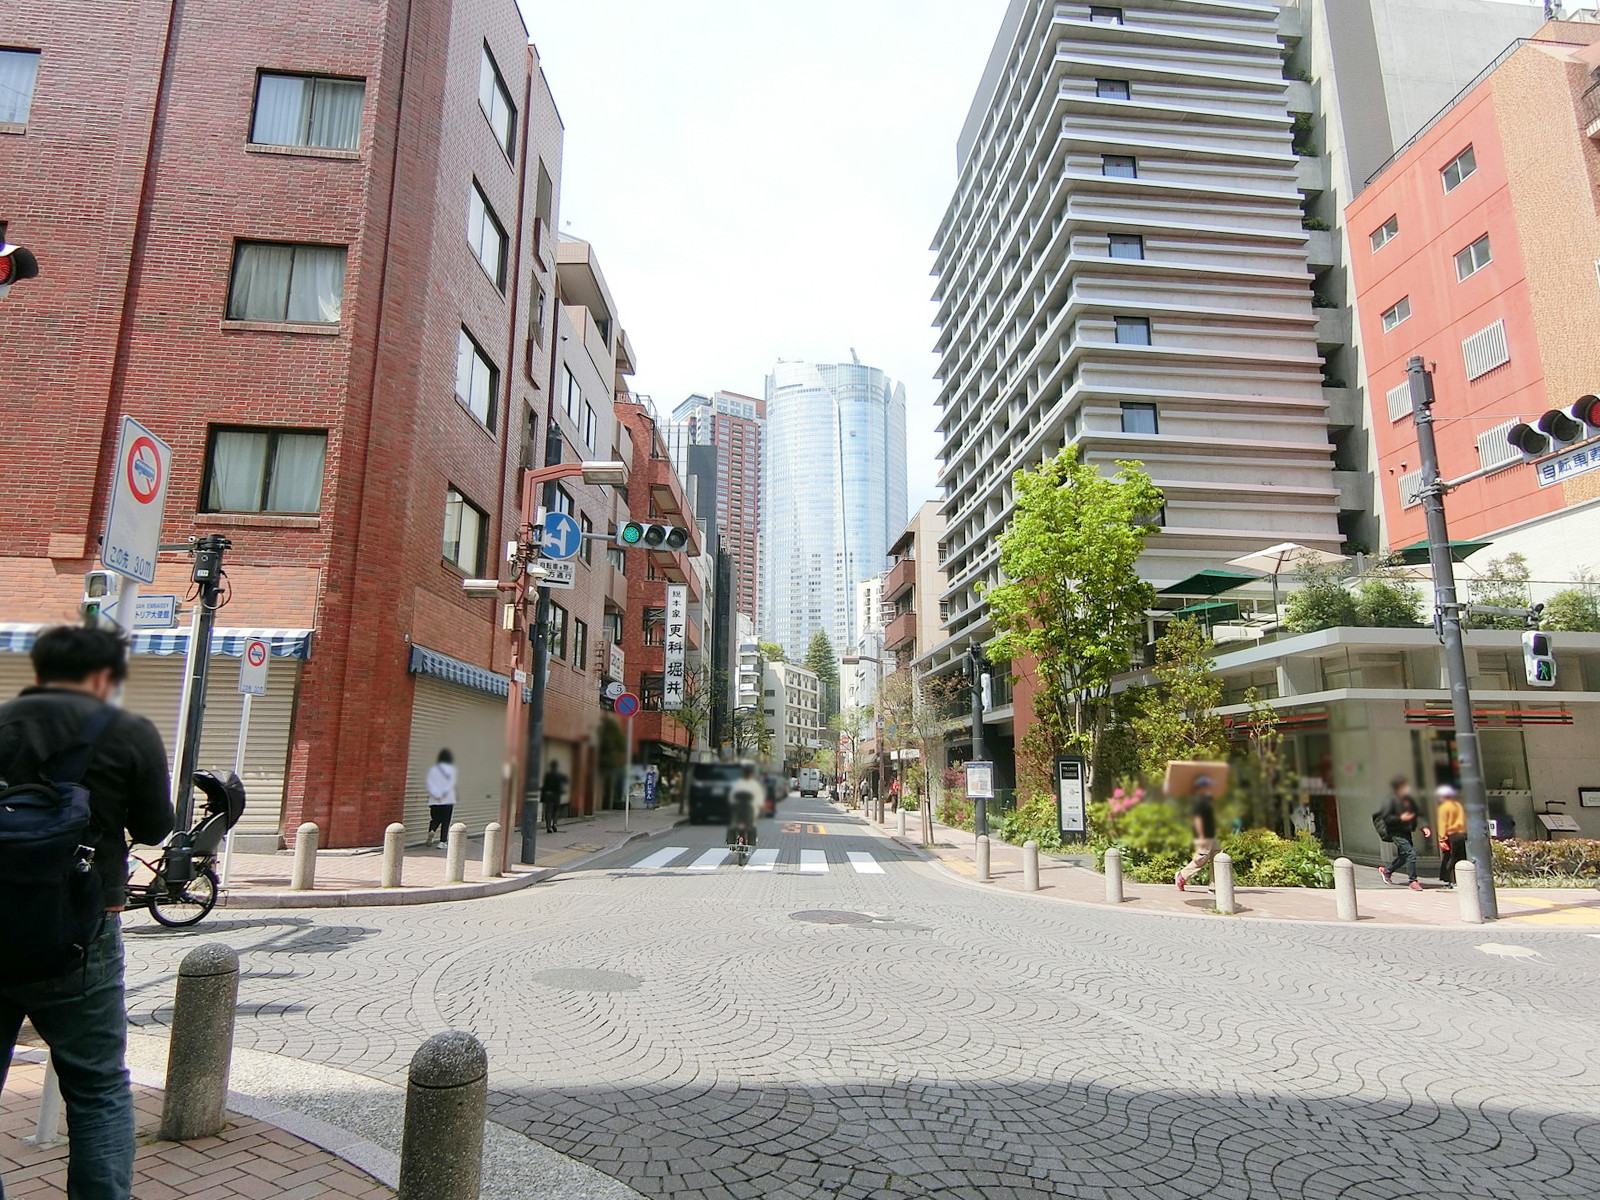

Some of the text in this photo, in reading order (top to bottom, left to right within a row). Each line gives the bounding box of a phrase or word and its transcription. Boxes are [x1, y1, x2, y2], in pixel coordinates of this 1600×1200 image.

[110, 546, 152, 578] この先 30m
[135, 610, 169, 619] トリア大使館
